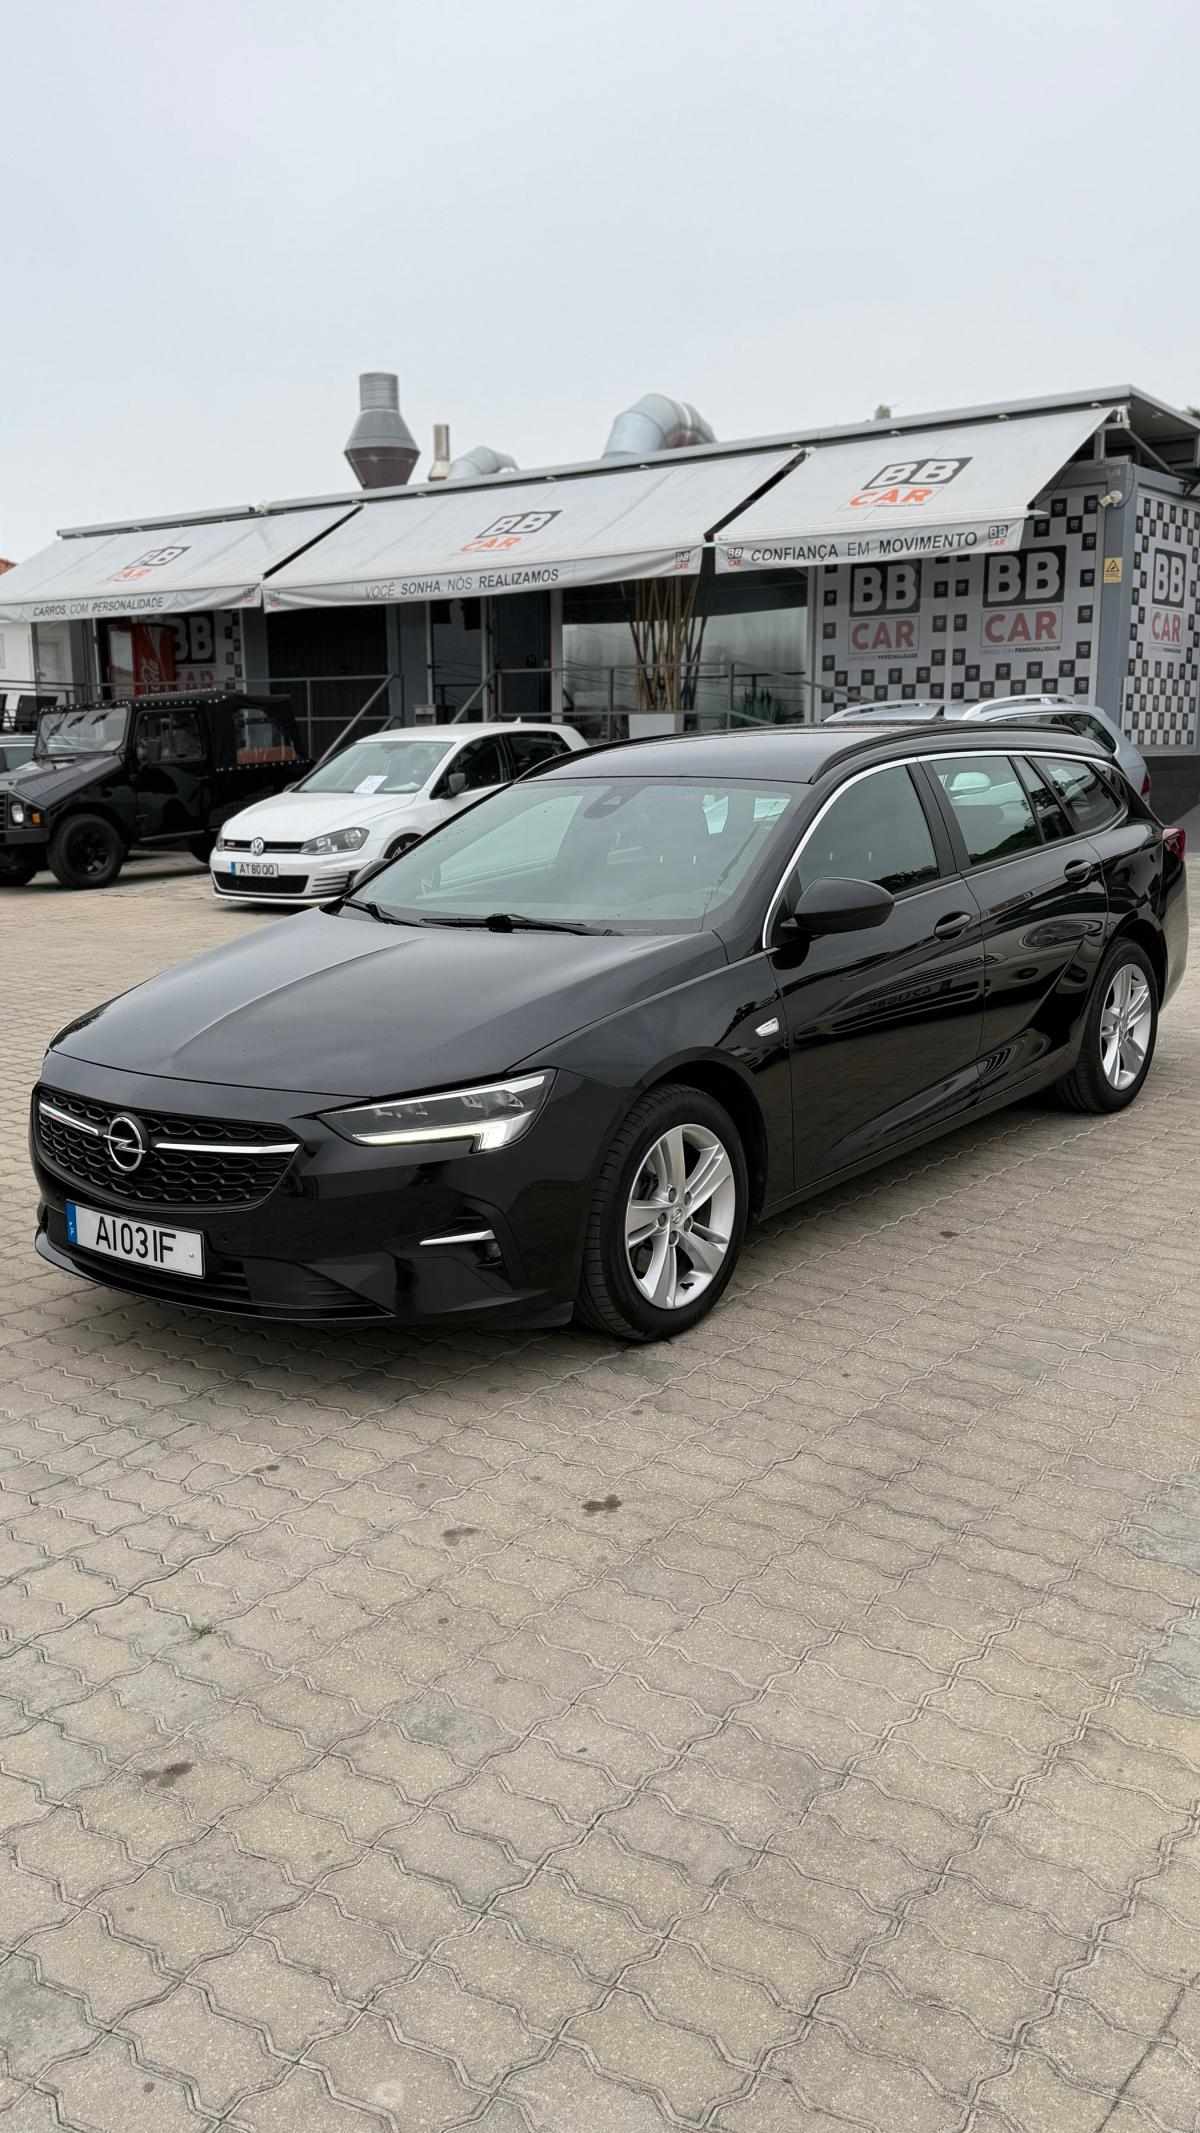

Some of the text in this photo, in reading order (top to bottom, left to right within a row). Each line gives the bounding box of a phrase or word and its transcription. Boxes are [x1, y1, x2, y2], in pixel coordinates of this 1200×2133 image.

[865, 458, 965, 489] BB
[849, 488, 932, 506] CAR
[478, 511, 557, 537] BB
[463, 536, 521, 550] CAR
[751, 532, 978, 562] CONFIANÇA EM MOVIMENTO
[400, 580, 441, 596] SONHA
[447, 577, 473, 591] NÓS
[479, 569, 559, 588] REALIZAMOS
[853, 565, 917, 612] BB
[987, 552, 1060, 602] BB
[1153, 553, 1184, 602] BB
[33, 597, 164, 616] CARROS COM PERSONALIDADE
[852, 621, 914, 650] CAR
[985, 611, 1057, 642] CAR
[1152, 611, 1181, 643] CAR
[96, 1216, 176, 1263] AI03IF
